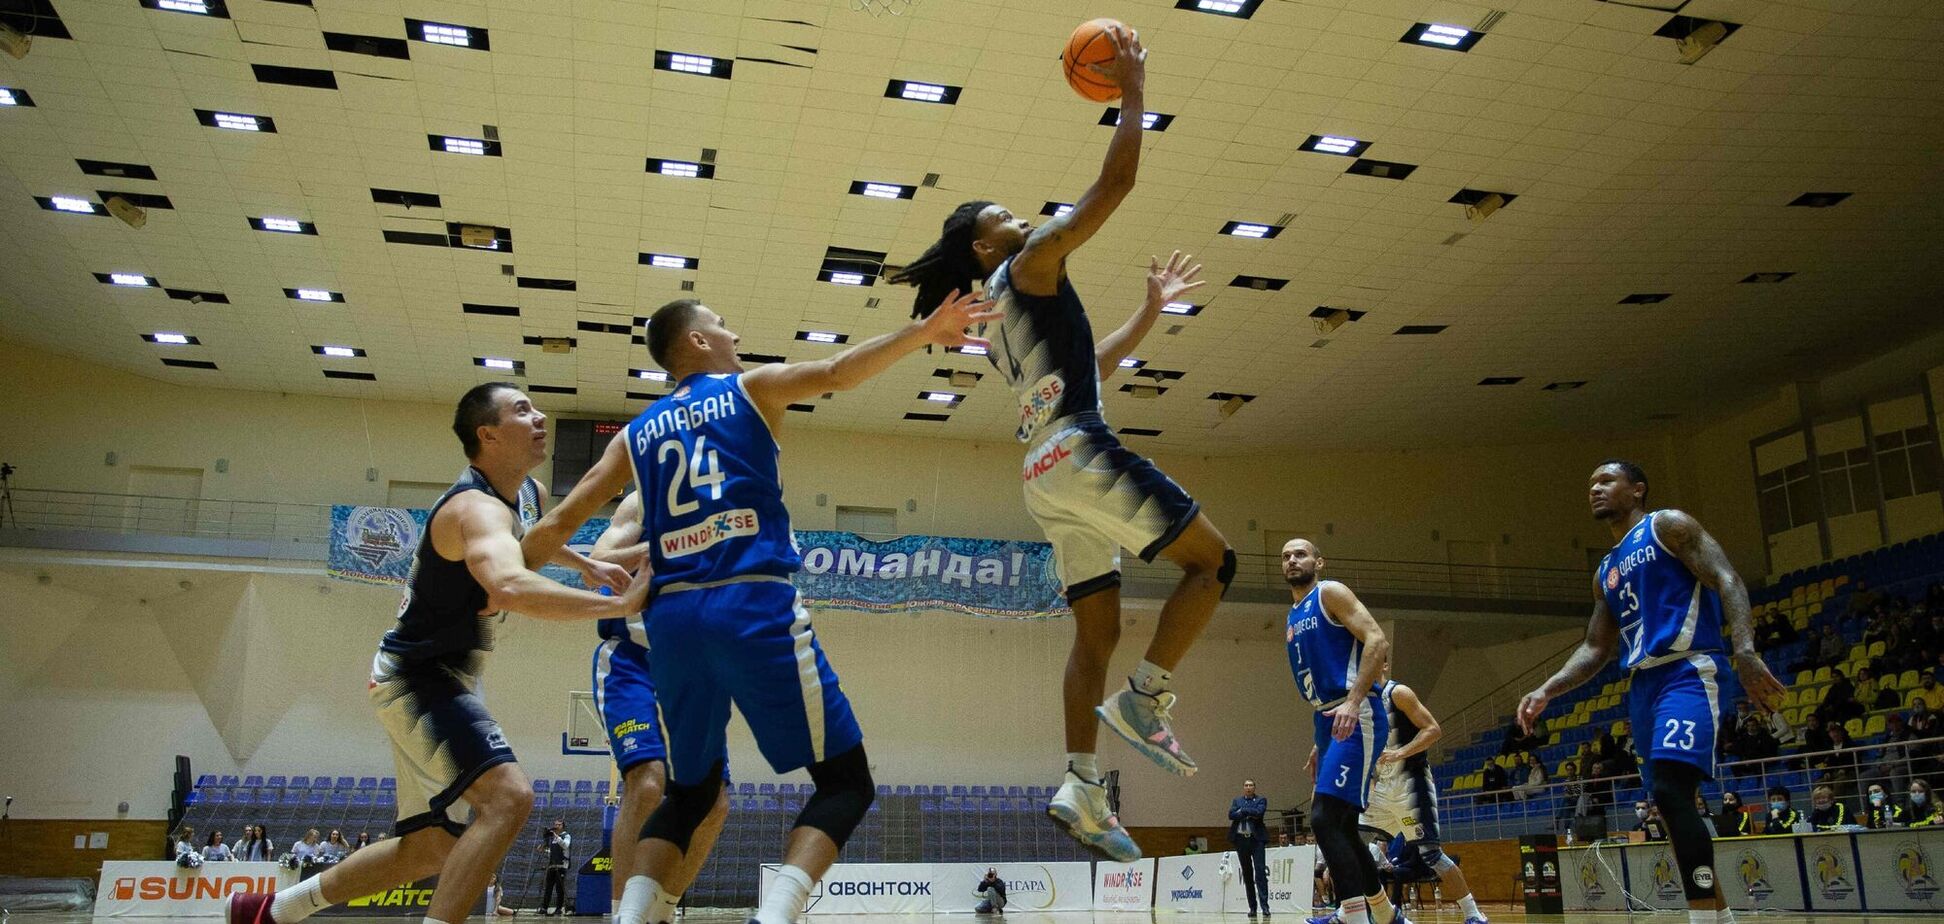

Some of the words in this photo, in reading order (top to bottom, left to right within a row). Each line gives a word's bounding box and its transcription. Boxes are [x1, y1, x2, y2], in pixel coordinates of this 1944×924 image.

[636, 391, 736, 456] БАЛАБАН
[657, 435, 726, 517] 24
[801, 546, 1025, 588] оманда!
[1618, 545, 1656, 576] ОДЕСА
[1662, 718, 1696, 750] 23
[1335, 764, 1350, 788] 3
[347, 889, 434, 907] MATC
[828, 881, 931, 896] авантаж
[1003, 880, 1046, 892] НГАРД
